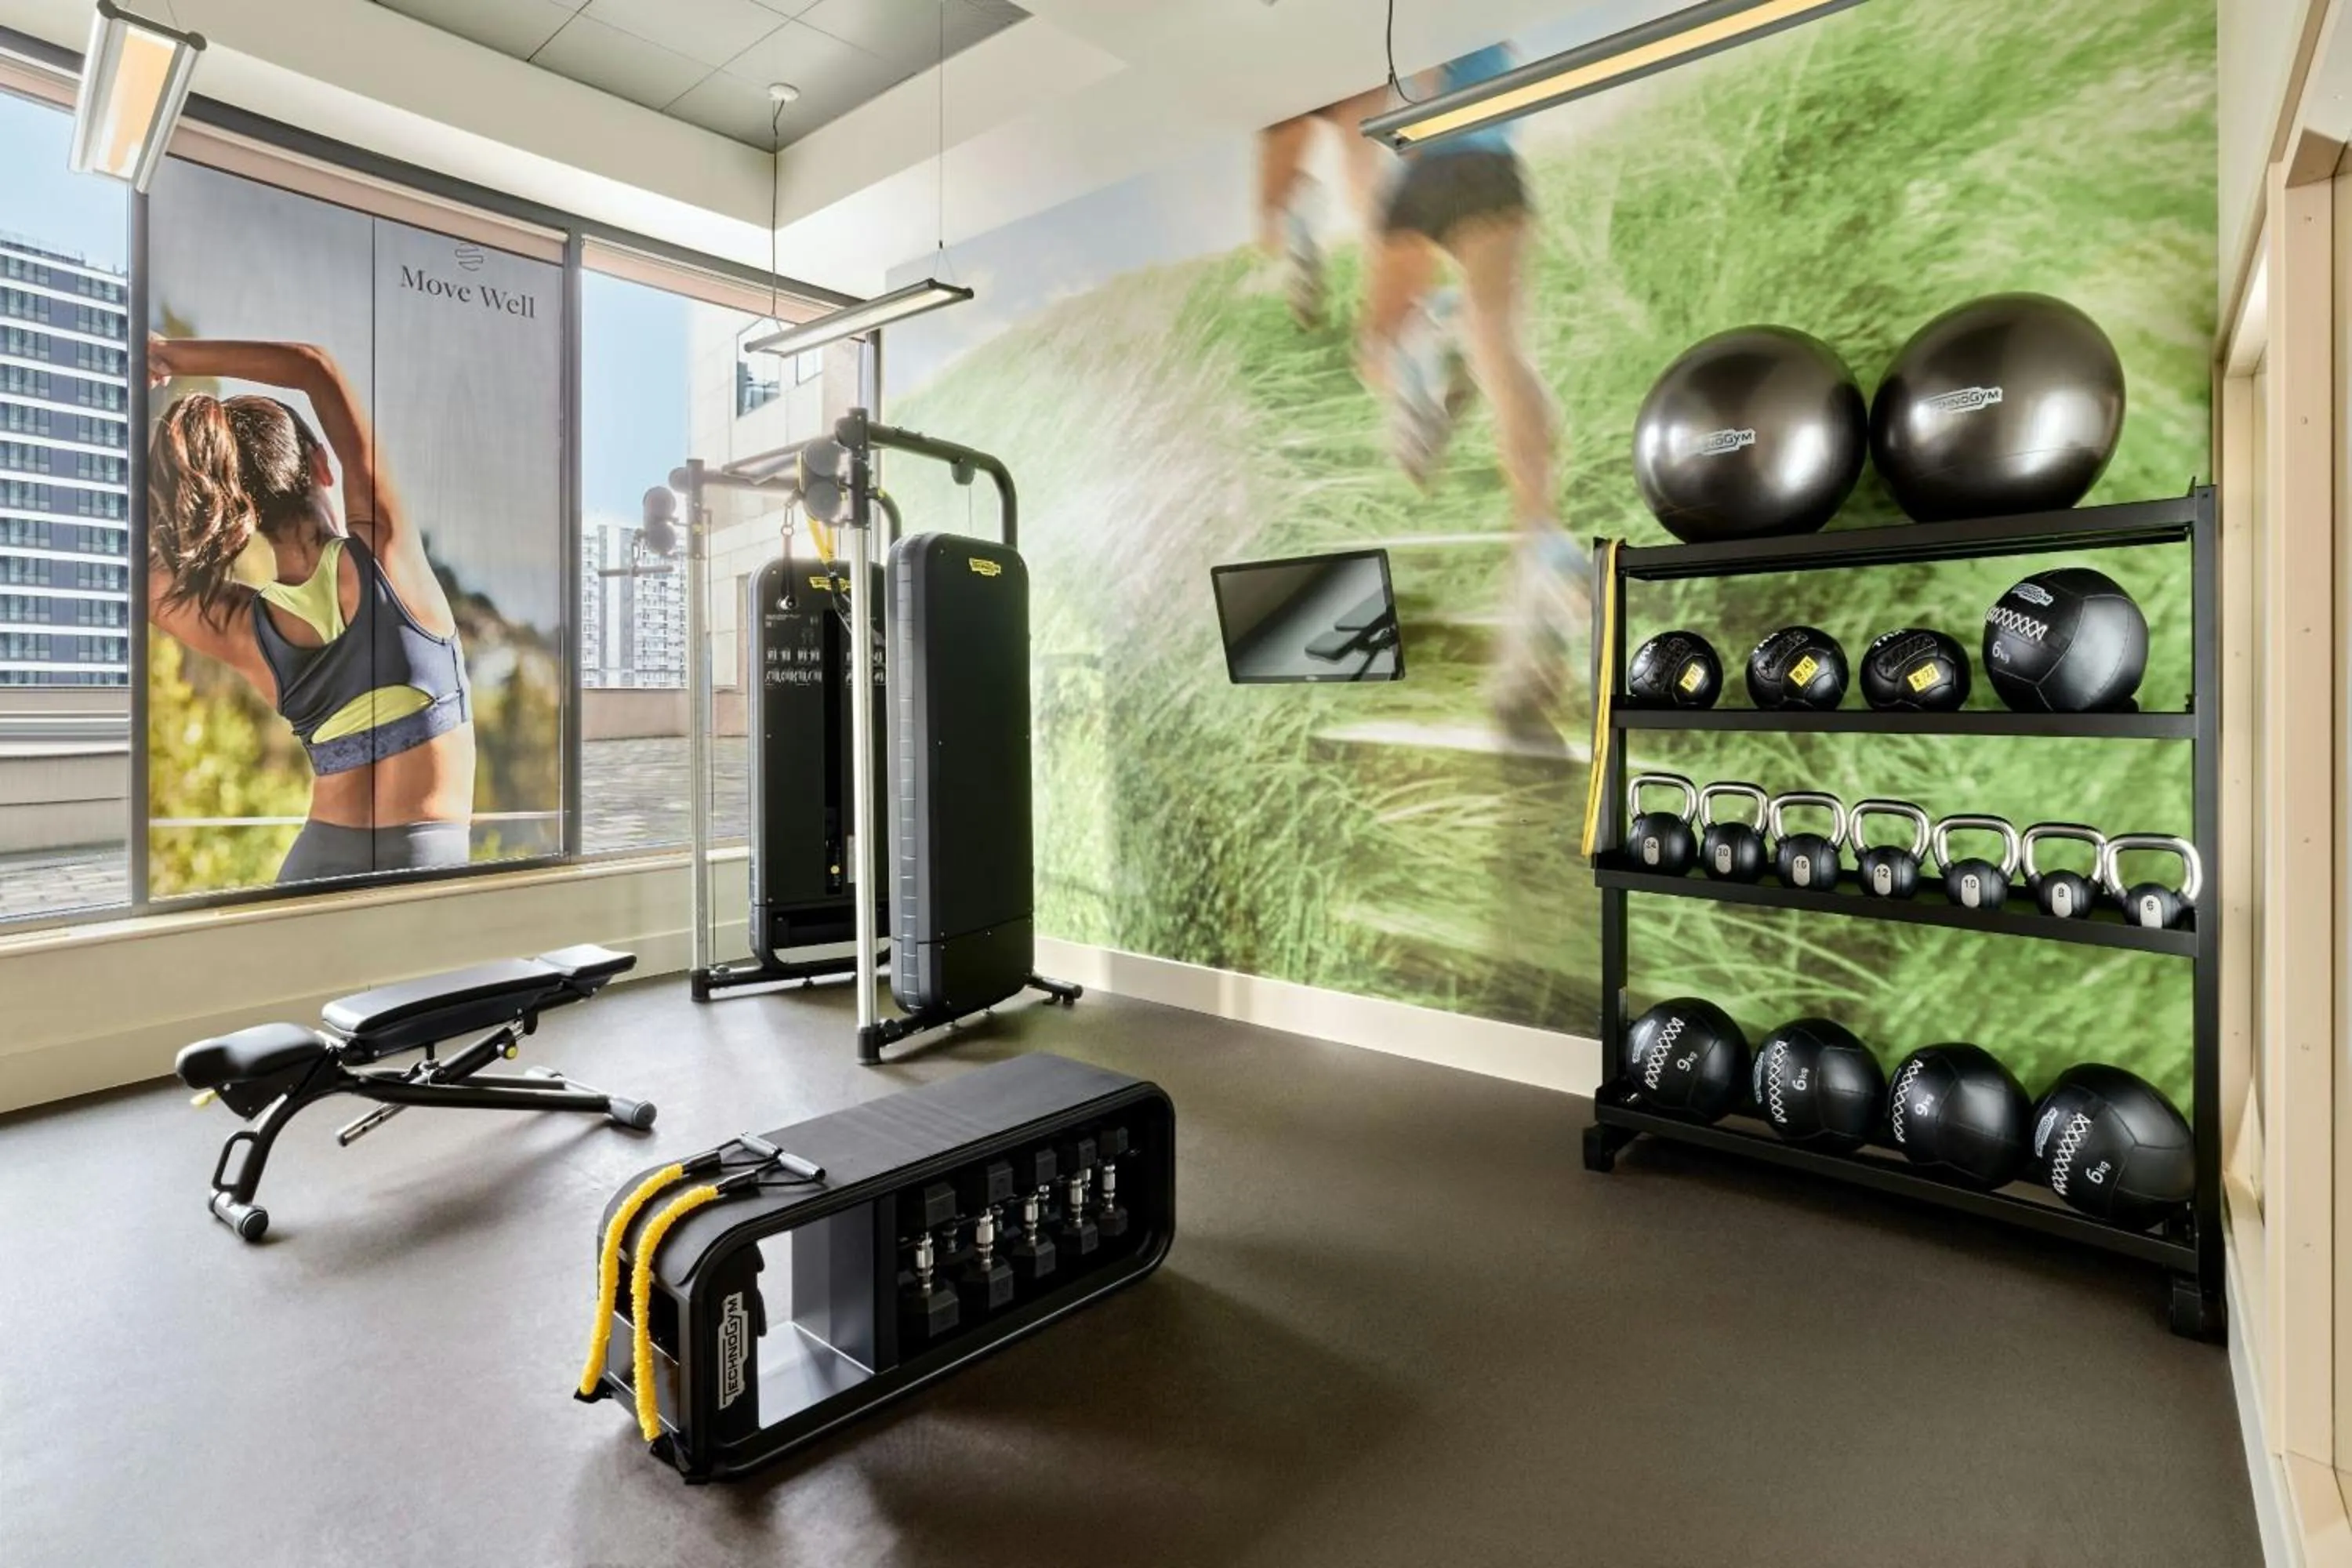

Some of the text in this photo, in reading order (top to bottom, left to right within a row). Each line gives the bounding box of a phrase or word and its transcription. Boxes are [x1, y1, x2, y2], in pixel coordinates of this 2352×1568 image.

[401, 265, 535, 319] Move Well
[1876, 868, 1888, 878] 12
[1964, 878, 1976, 888] 10
[2058, 887, 2065, 898] 8
